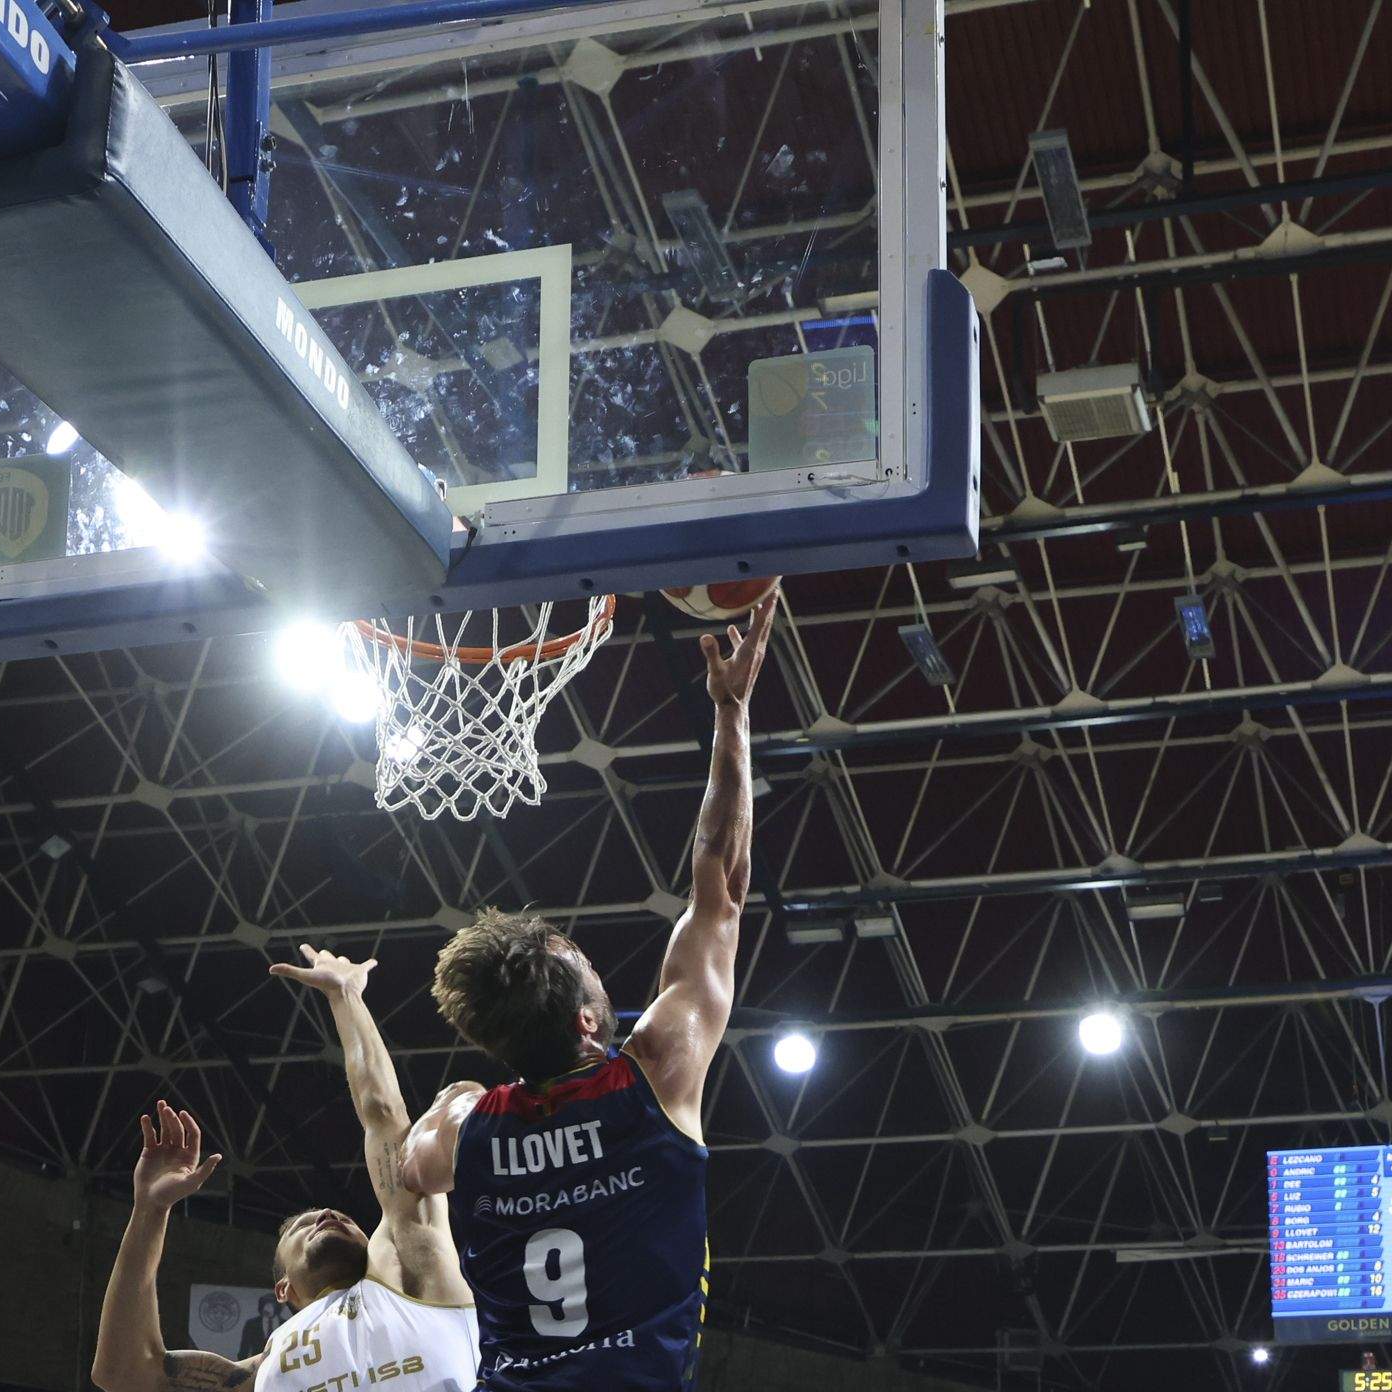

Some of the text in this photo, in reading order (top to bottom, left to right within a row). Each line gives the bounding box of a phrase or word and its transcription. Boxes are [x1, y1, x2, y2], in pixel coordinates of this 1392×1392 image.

[275, 296, 349, 410] MONDO
[491, 1120, 604, 1176] LLOVET
[495, 1166, 646, 1216] MORABANC
[523, 1228, 589, 1338] 9
[1327, 1315, 1392, 1332] GOLDEN
[280, 1324, 322, 1374] 25
[368, 1355, 425, 1384] ISB
[1354, 1372, 1392, 1392] 5:25
